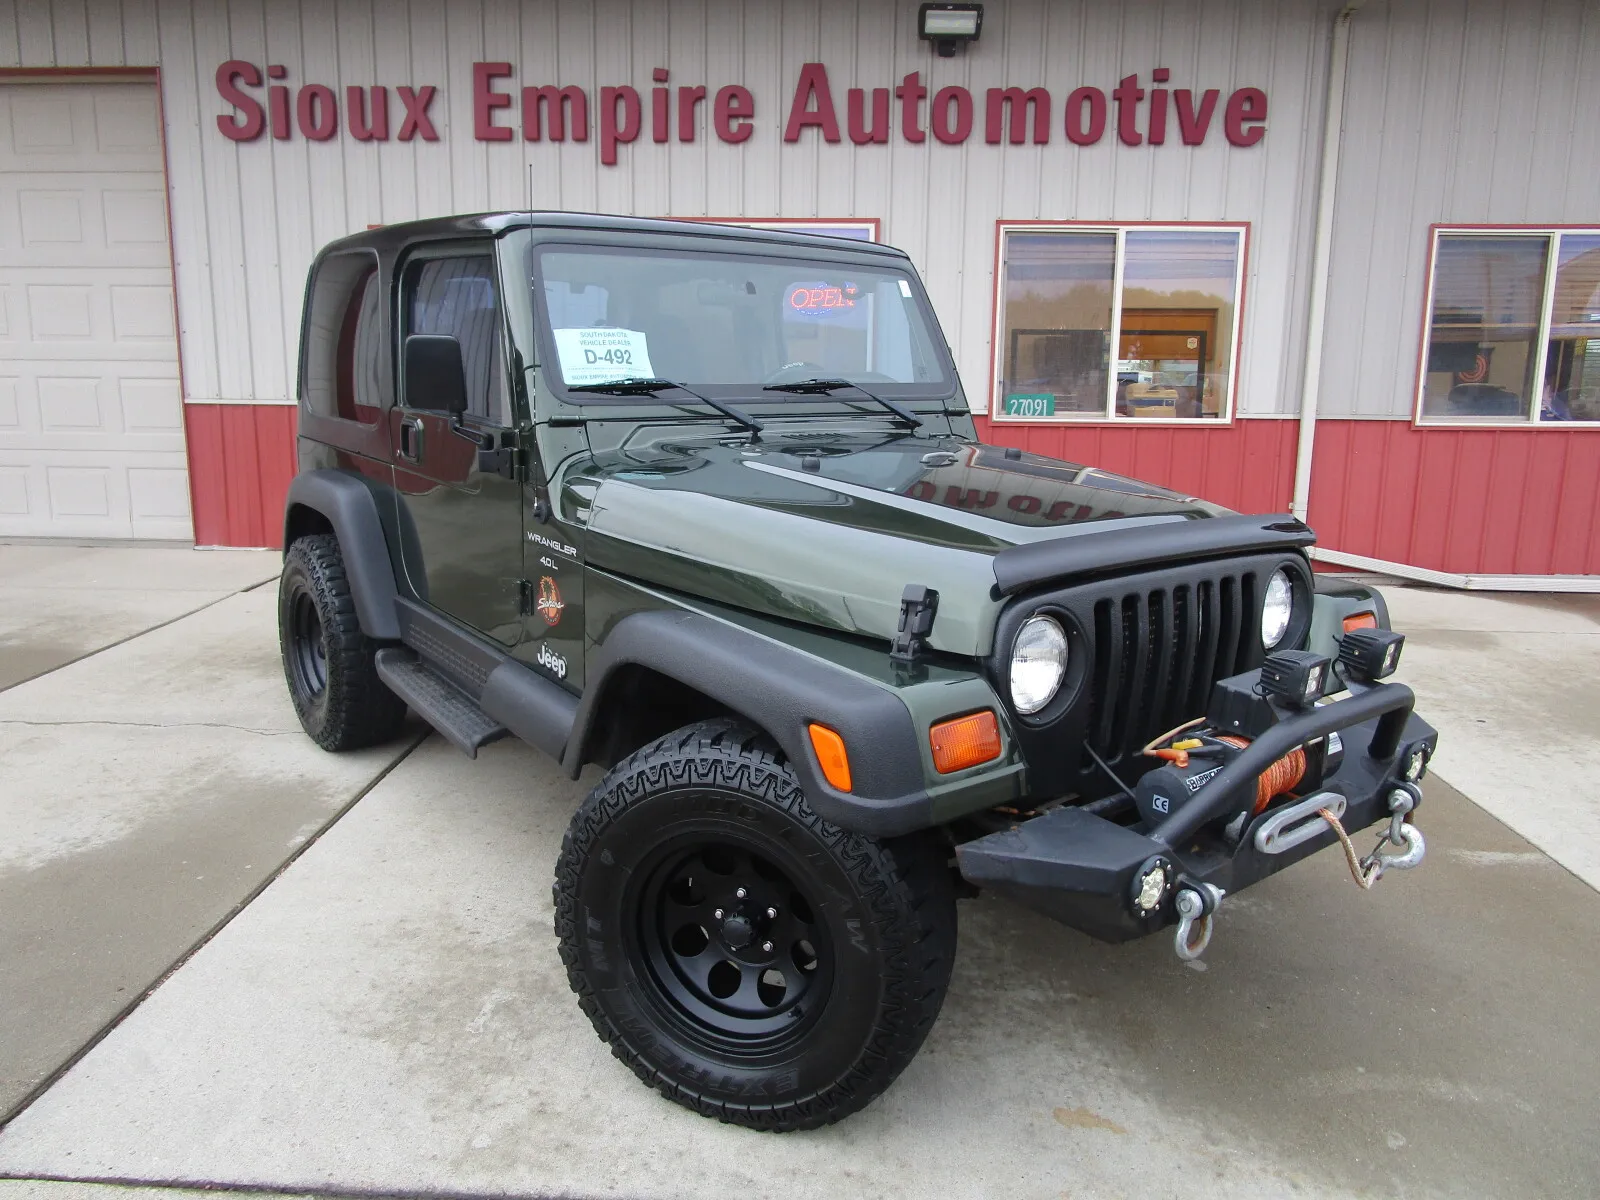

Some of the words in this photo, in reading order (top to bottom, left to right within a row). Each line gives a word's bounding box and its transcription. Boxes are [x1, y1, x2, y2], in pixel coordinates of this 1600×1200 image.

[215, 60, 439, 142] Sioux
[472, 61, 755, 165] Empire
[783, 62, 1268, 148] Automotive
[604, 331, 628, 339] DAKOTA
[584, 349, 633, 365] D-492
[1010, 398, 1047, 416] 27091
[526, 531, 577, 557] WRANGLER
[537, 645, 567, 678] Jeep
[1153, 796, 1169, 812] CE
